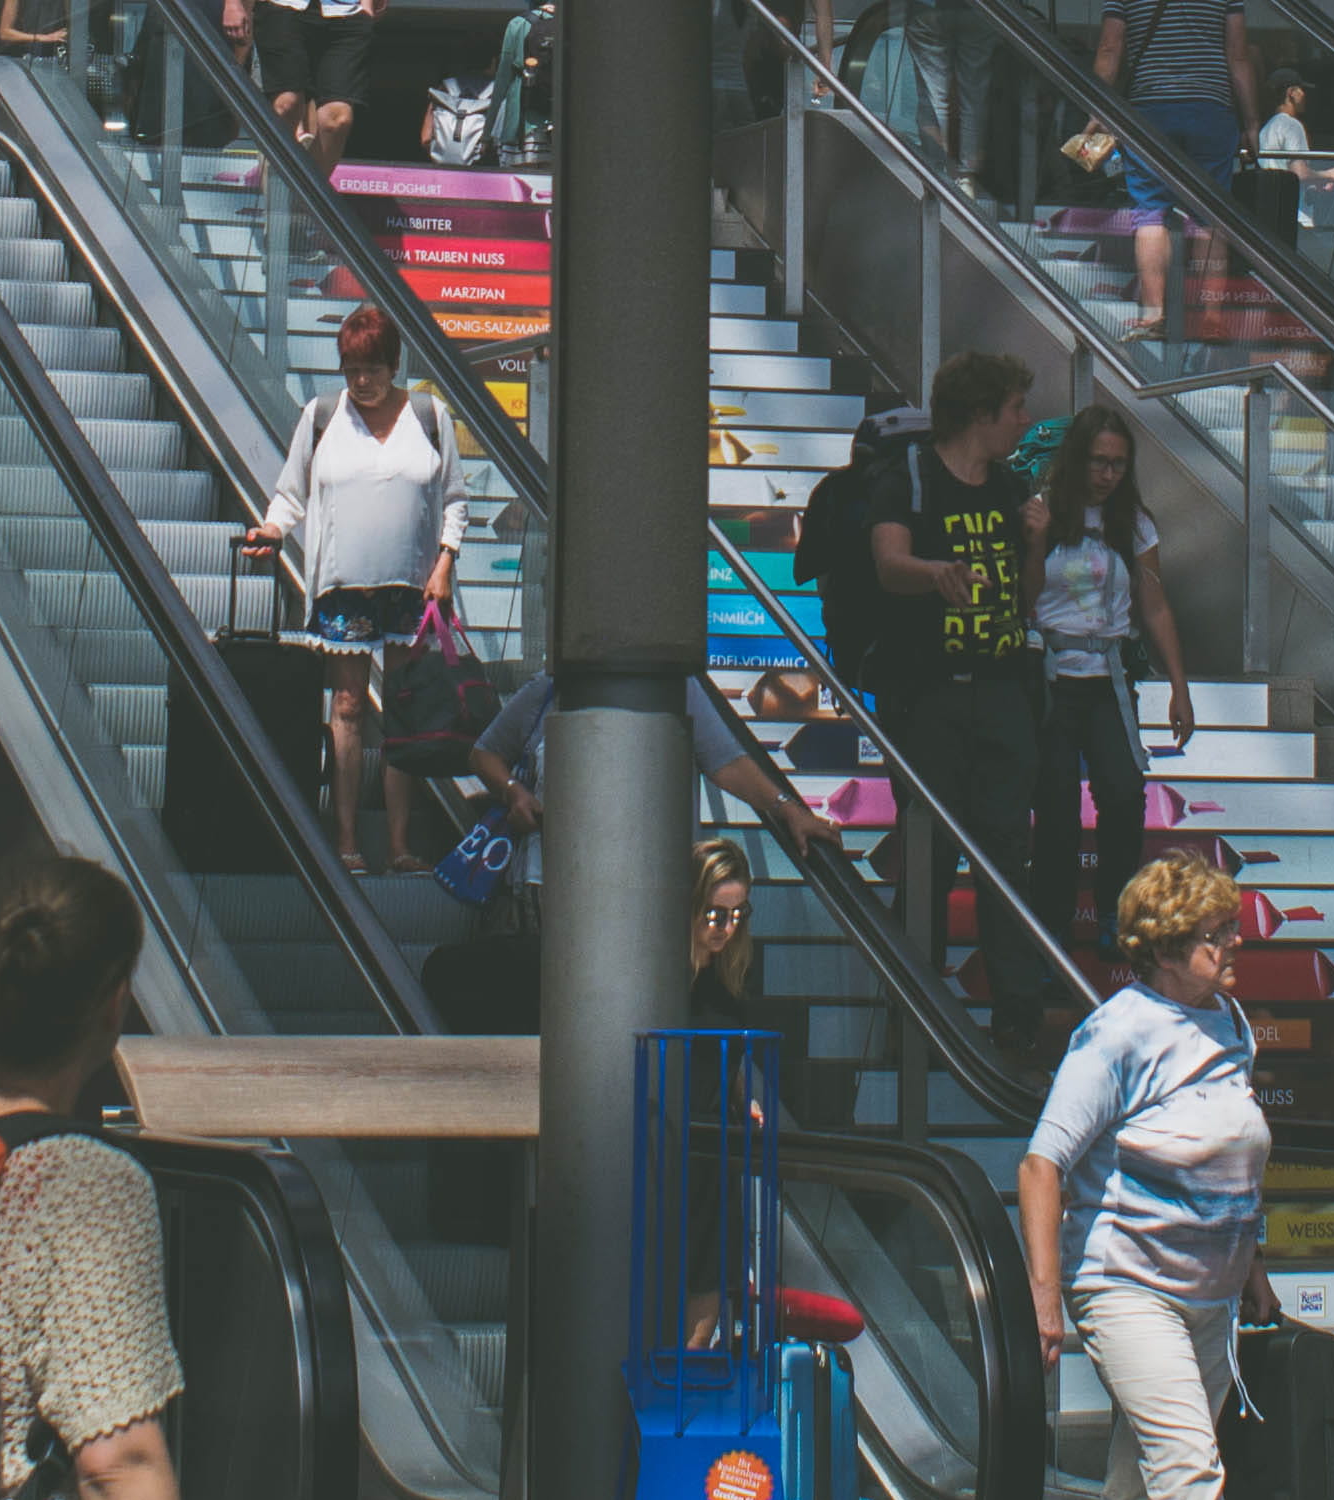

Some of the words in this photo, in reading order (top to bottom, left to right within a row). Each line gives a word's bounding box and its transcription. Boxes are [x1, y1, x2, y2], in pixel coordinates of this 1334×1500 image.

[340, 178, 389, 193] ERDBEER
[391, 181, 442, 195] JOGHURT
[414, 249, 468, 263] TRAUBEN
[471, 251, 505, 266] NUSS
[440, 286, 506, 300] MARZIPAN
